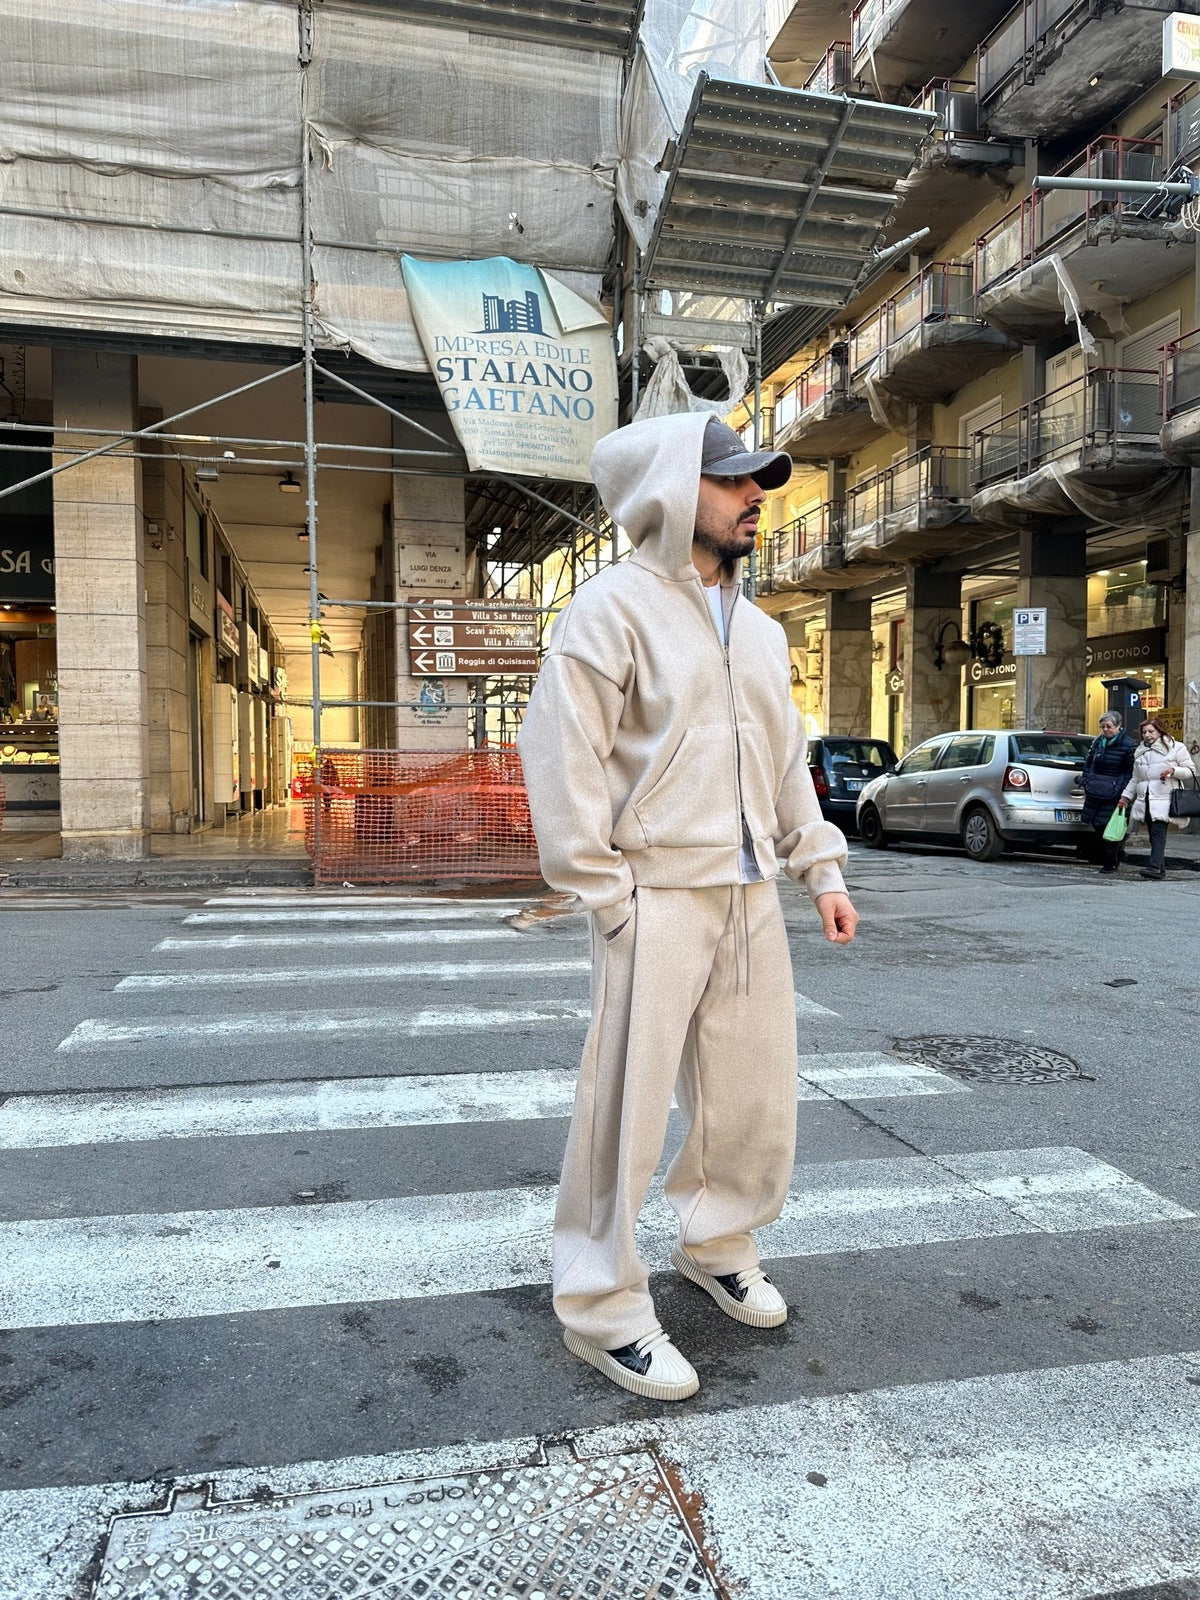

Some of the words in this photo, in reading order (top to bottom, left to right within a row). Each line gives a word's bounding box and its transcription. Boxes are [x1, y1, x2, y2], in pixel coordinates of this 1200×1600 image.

[434, 335, 529, 356] IMPRESA
[534, 341, 591, 365] EDILE
[436, 357, 593, 393] STAIANO
[443, 387, 595, 421] GAETANO
[463, 417, 476, 425] Via
[479, 418, 513, 428] Madonna
[515, 421, 533, 431] delle
[485, 428, 505, 437] Santa
[507, 430, 529, 439] Maria
[484, 438, 496, 447] per
[410, 564, 428, 572] LUIGI
[429, 565, 452, 573] DENZA
[472, 611, 490, 620] Villa
[493, 612, 508, 621] San
[511, 612, 533, 621] Marco
[465, 626, 485, 635] Scavi
[484, 637, 502, 647] Villa
[505, 638, 533, 647] Arianna
[458, 657, 486, 667] Reggia
[497, 658, 536, 666] Quisisana
[1130, 693, 1139, 707] P
[384, 1484, 466, 1508] open
[303, 1497, 373, 1521] fiber
